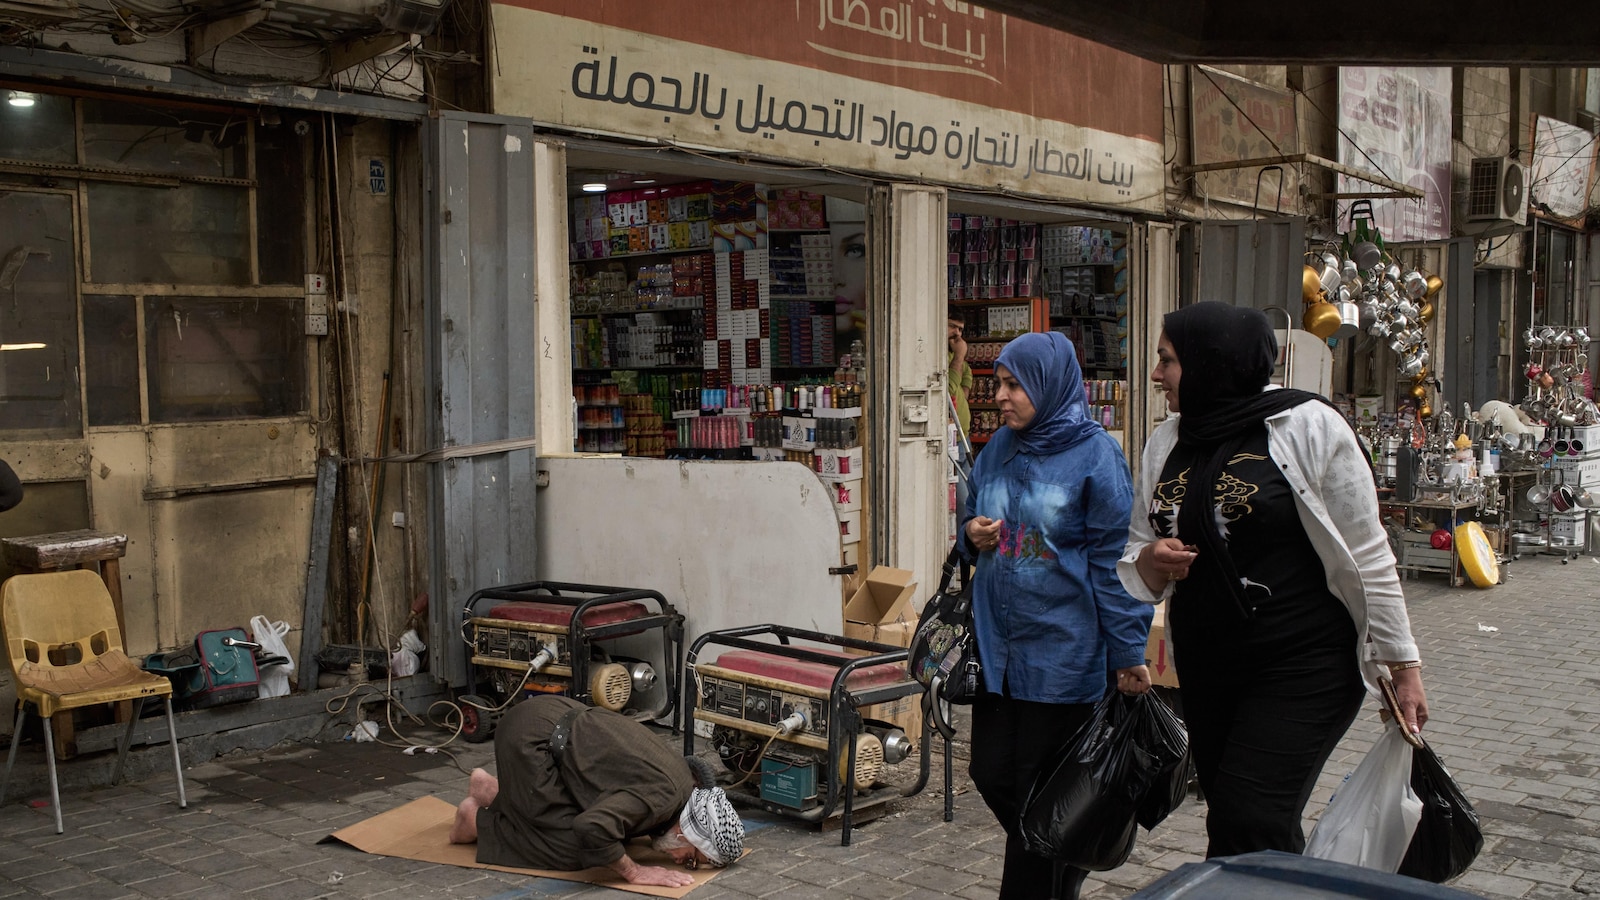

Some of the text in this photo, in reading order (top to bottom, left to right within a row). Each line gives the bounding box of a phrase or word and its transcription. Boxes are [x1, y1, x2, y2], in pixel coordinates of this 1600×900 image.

[818, 0, 986, 68] بيت العطار
[571, 45, 1134, 196] بيت العطار لتجارة مواد التجميل بالجملة
